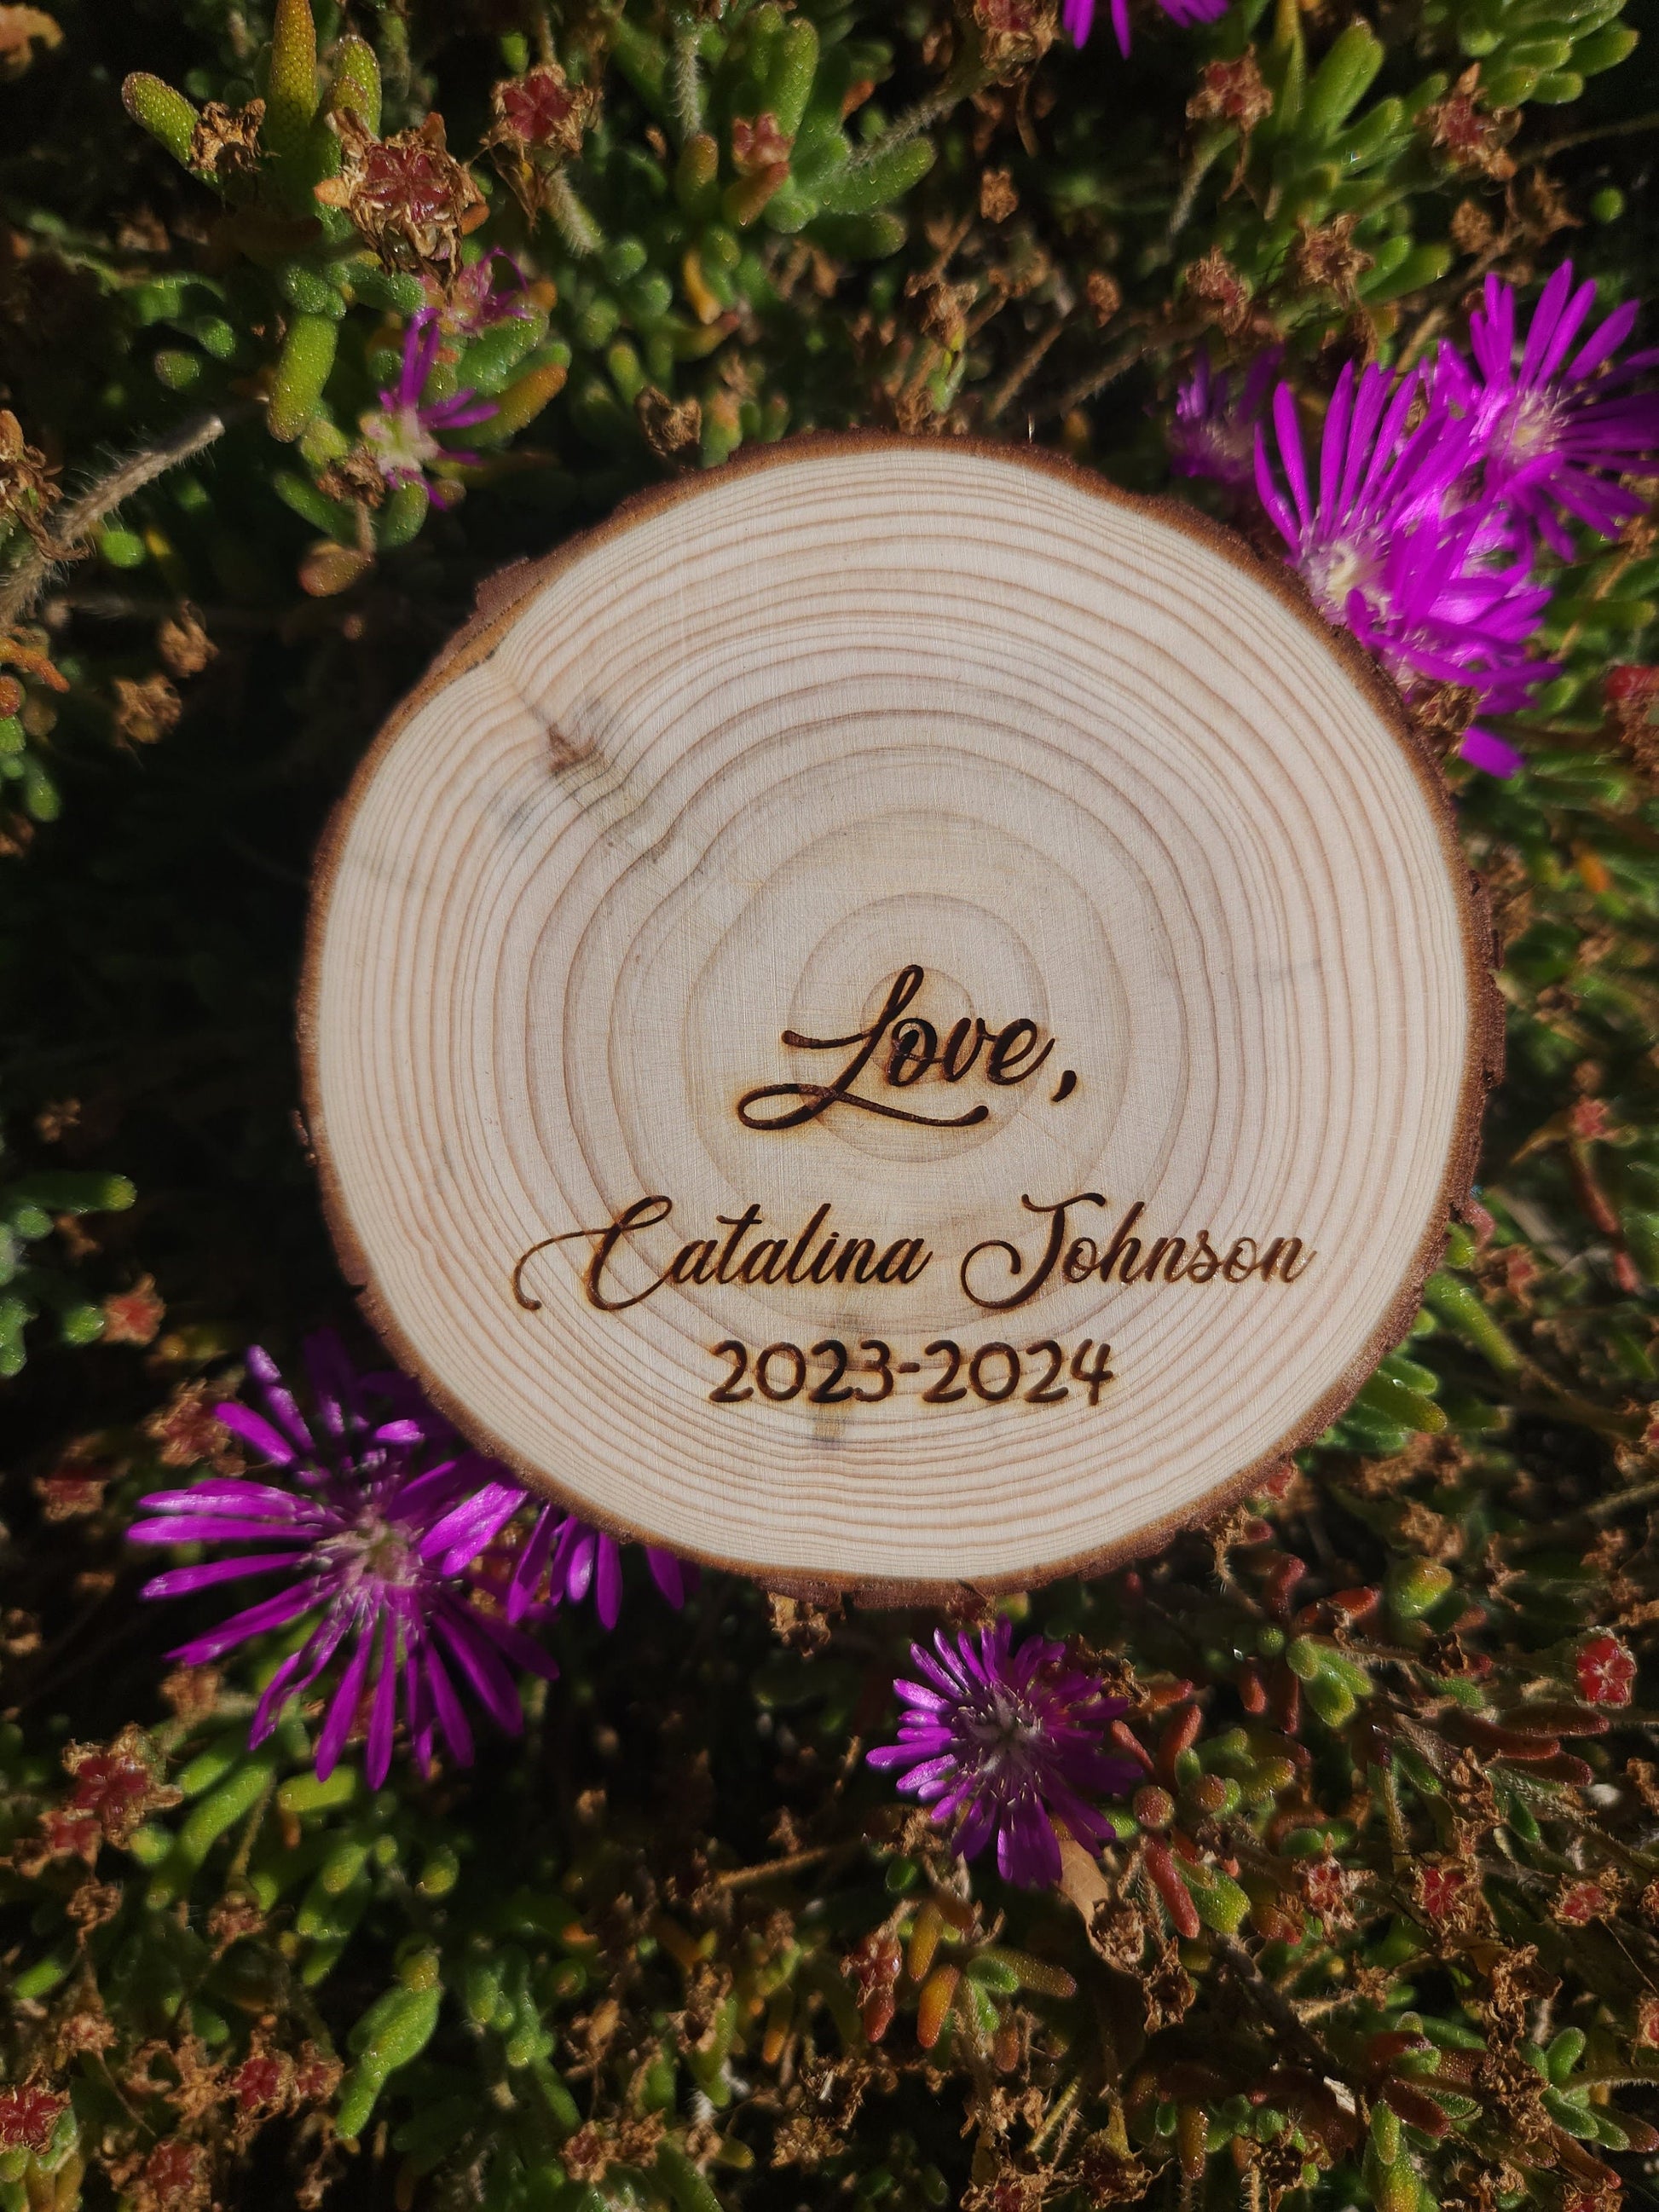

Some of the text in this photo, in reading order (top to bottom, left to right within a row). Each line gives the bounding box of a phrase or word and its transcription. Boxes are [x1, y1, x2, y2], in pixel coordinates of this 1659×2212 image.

[736, 964, 1077, 1131] Love,
[512, 1193, 1315, 1314] Catalina Johnson
[708, 1338, 1115, 1407] 2023-2024
